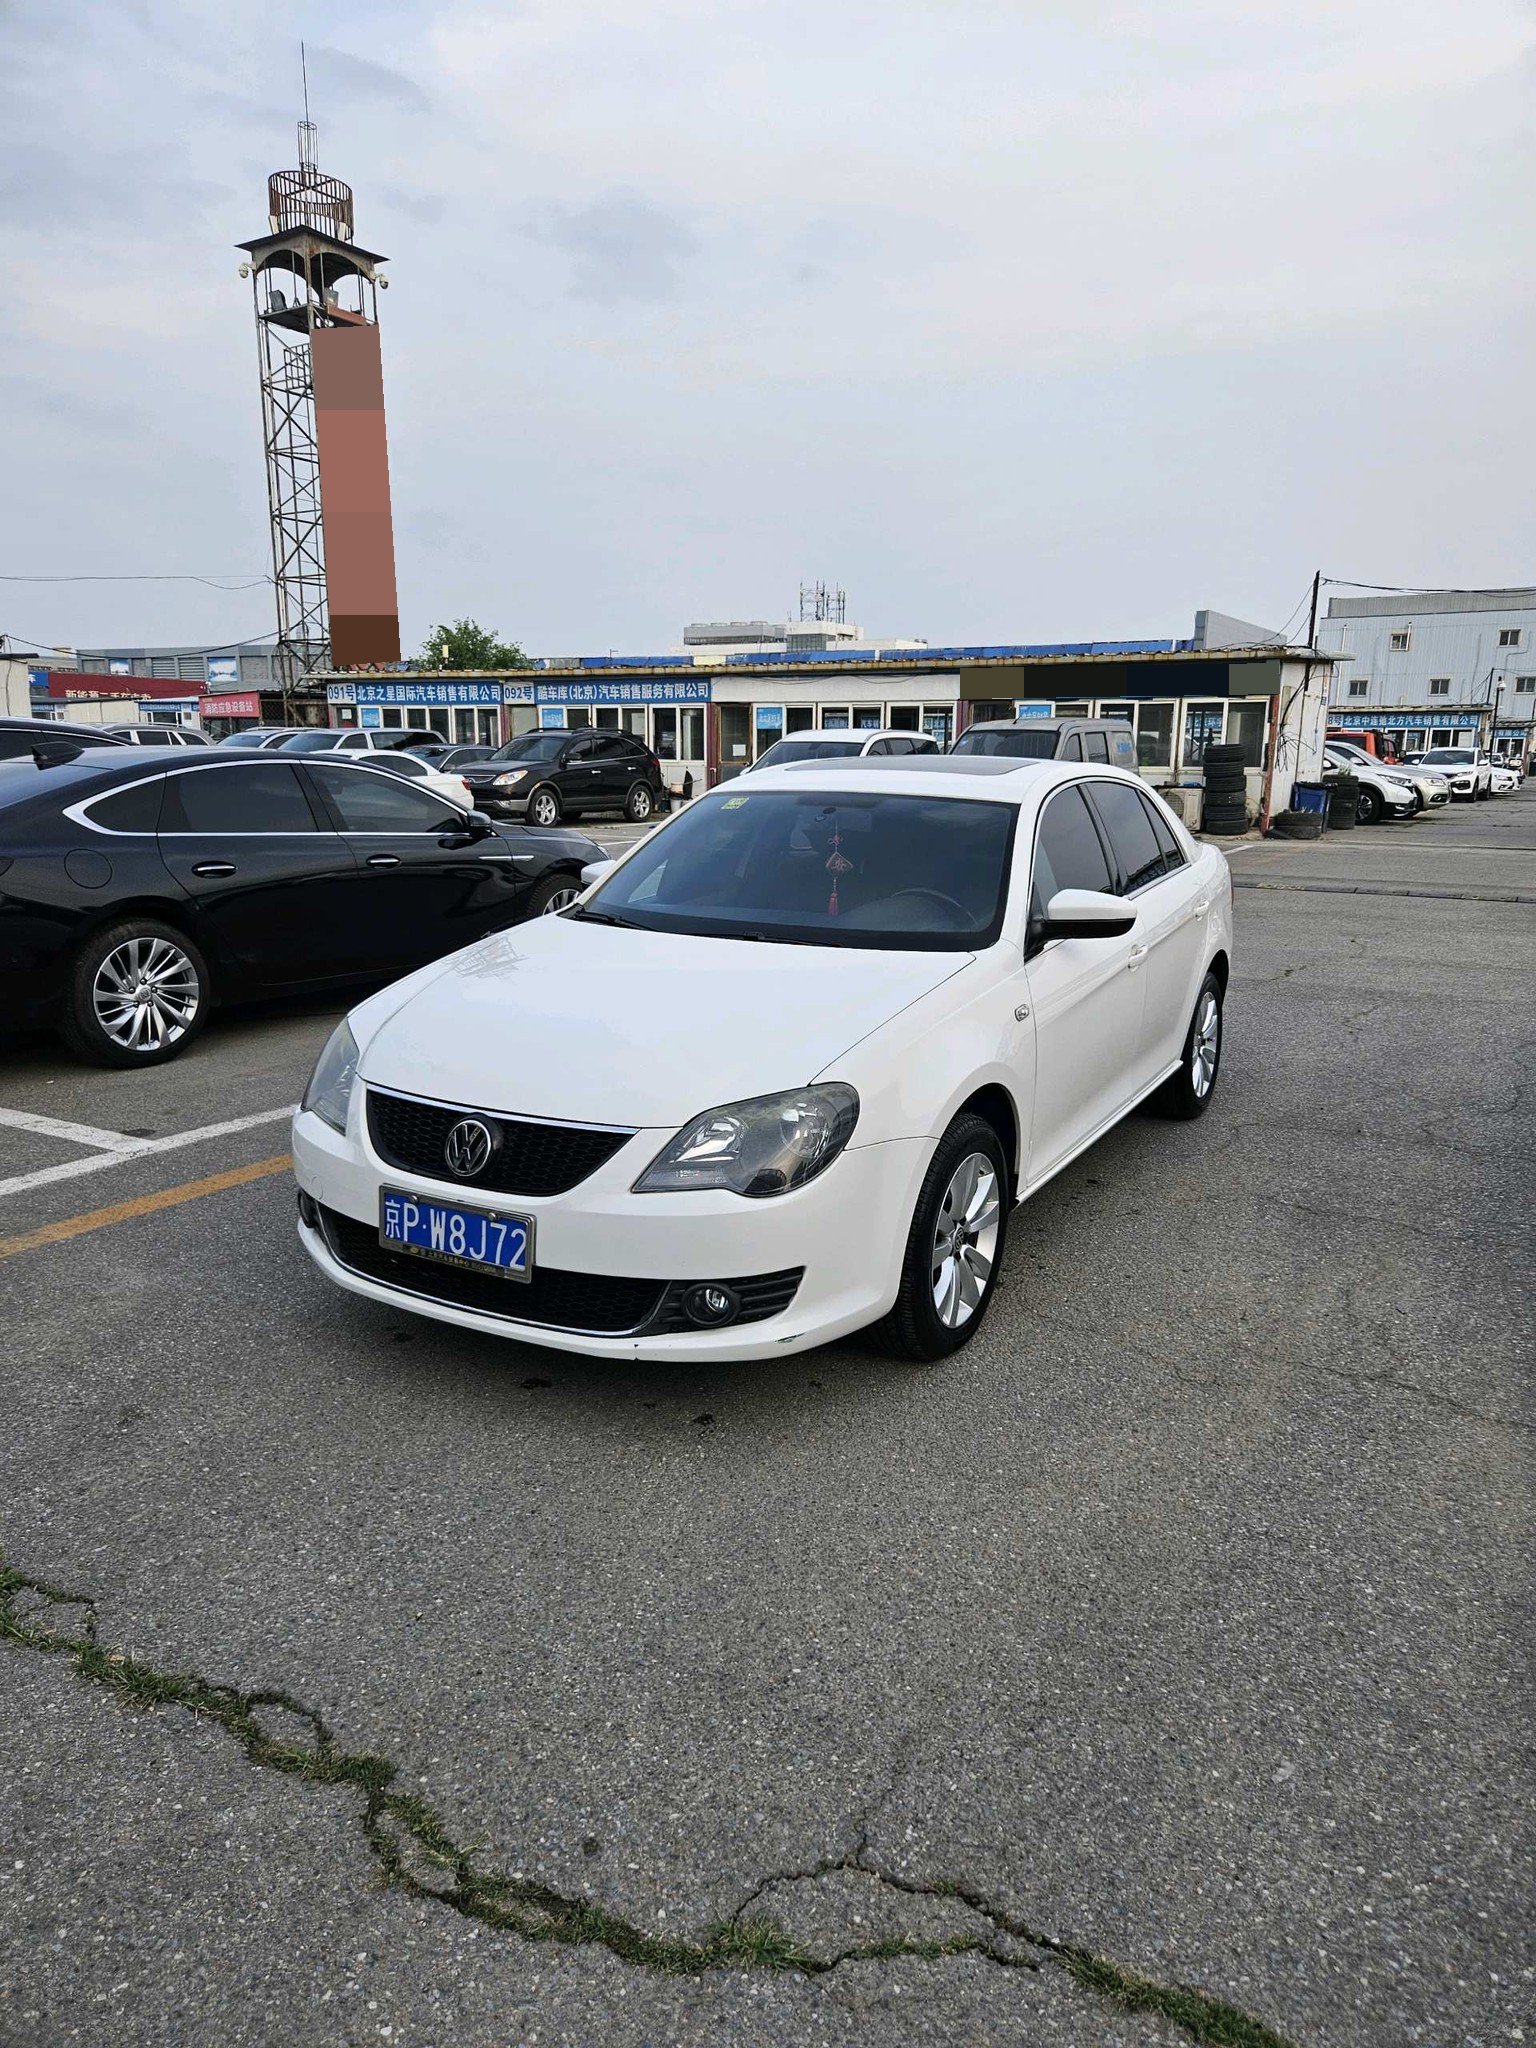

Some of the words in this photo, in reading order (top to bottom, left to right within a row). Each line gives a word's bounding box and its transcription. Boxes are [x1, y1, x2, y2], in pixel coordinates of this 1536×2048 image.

[327, 684, 355, 701] 091号
[357, 685, 501, 702] 北京之星国际汽车销售有限公司
[504, 685, 533, 700] 092号
